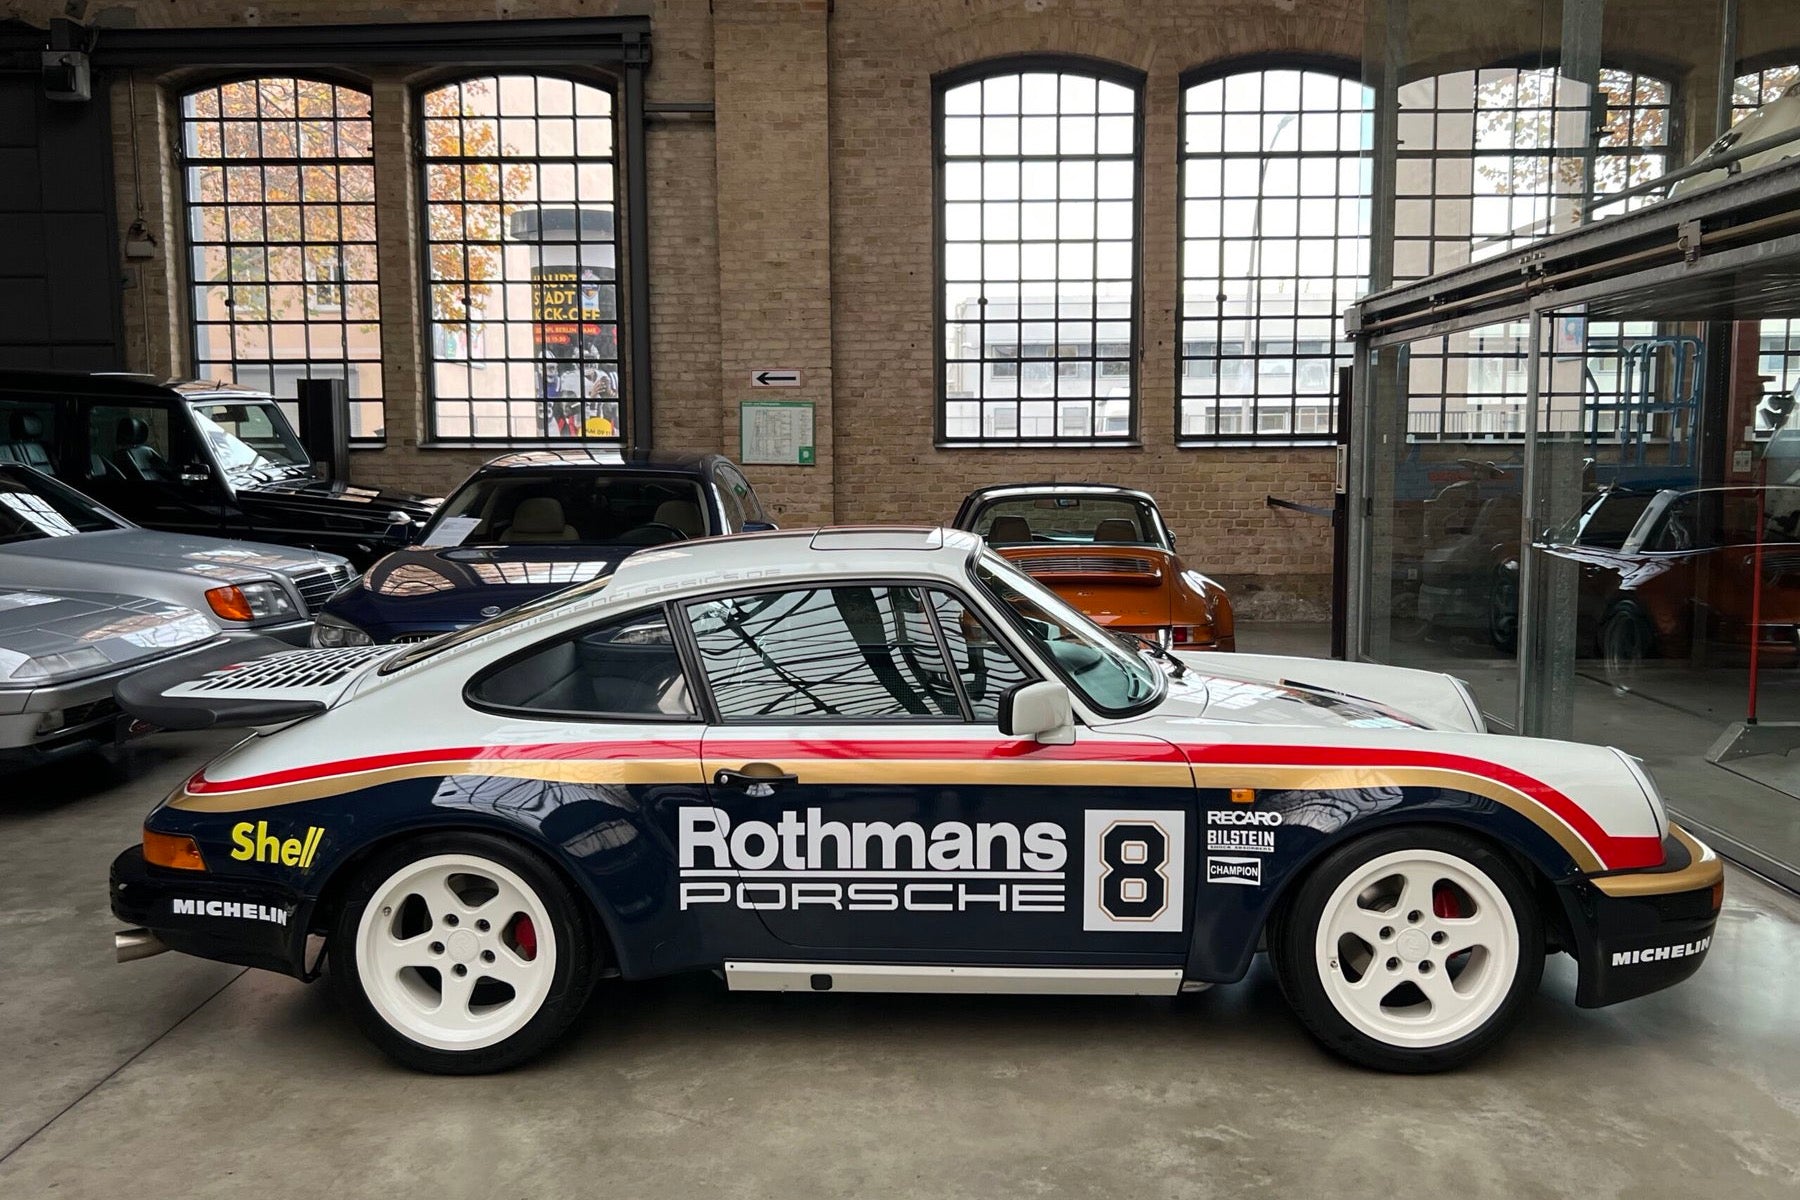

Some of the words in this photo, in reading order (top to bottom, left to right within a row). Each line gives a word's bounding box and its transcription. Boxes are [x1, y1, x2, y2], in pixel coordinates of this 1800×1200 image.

[534, 290, 576, 305] SADT
[534, 307, 600, 321] KCK-OFF
[1207, 810, 1283, 826] RECARO
[230, 820, 325, 868] Shell
[679, 806, 1067, 871] Rothmans
[1207, 829, 1275, 846] BILSTEIN
[1099, 820, 1170, 922] 8
[1210, 865, 1258, 877] CHAMPION
[679, 882, 1066, 913] PORSCHE
[173, 899, 287, 926] MICHELIN
[1612, 936, 1711, 966] MICHELIN
